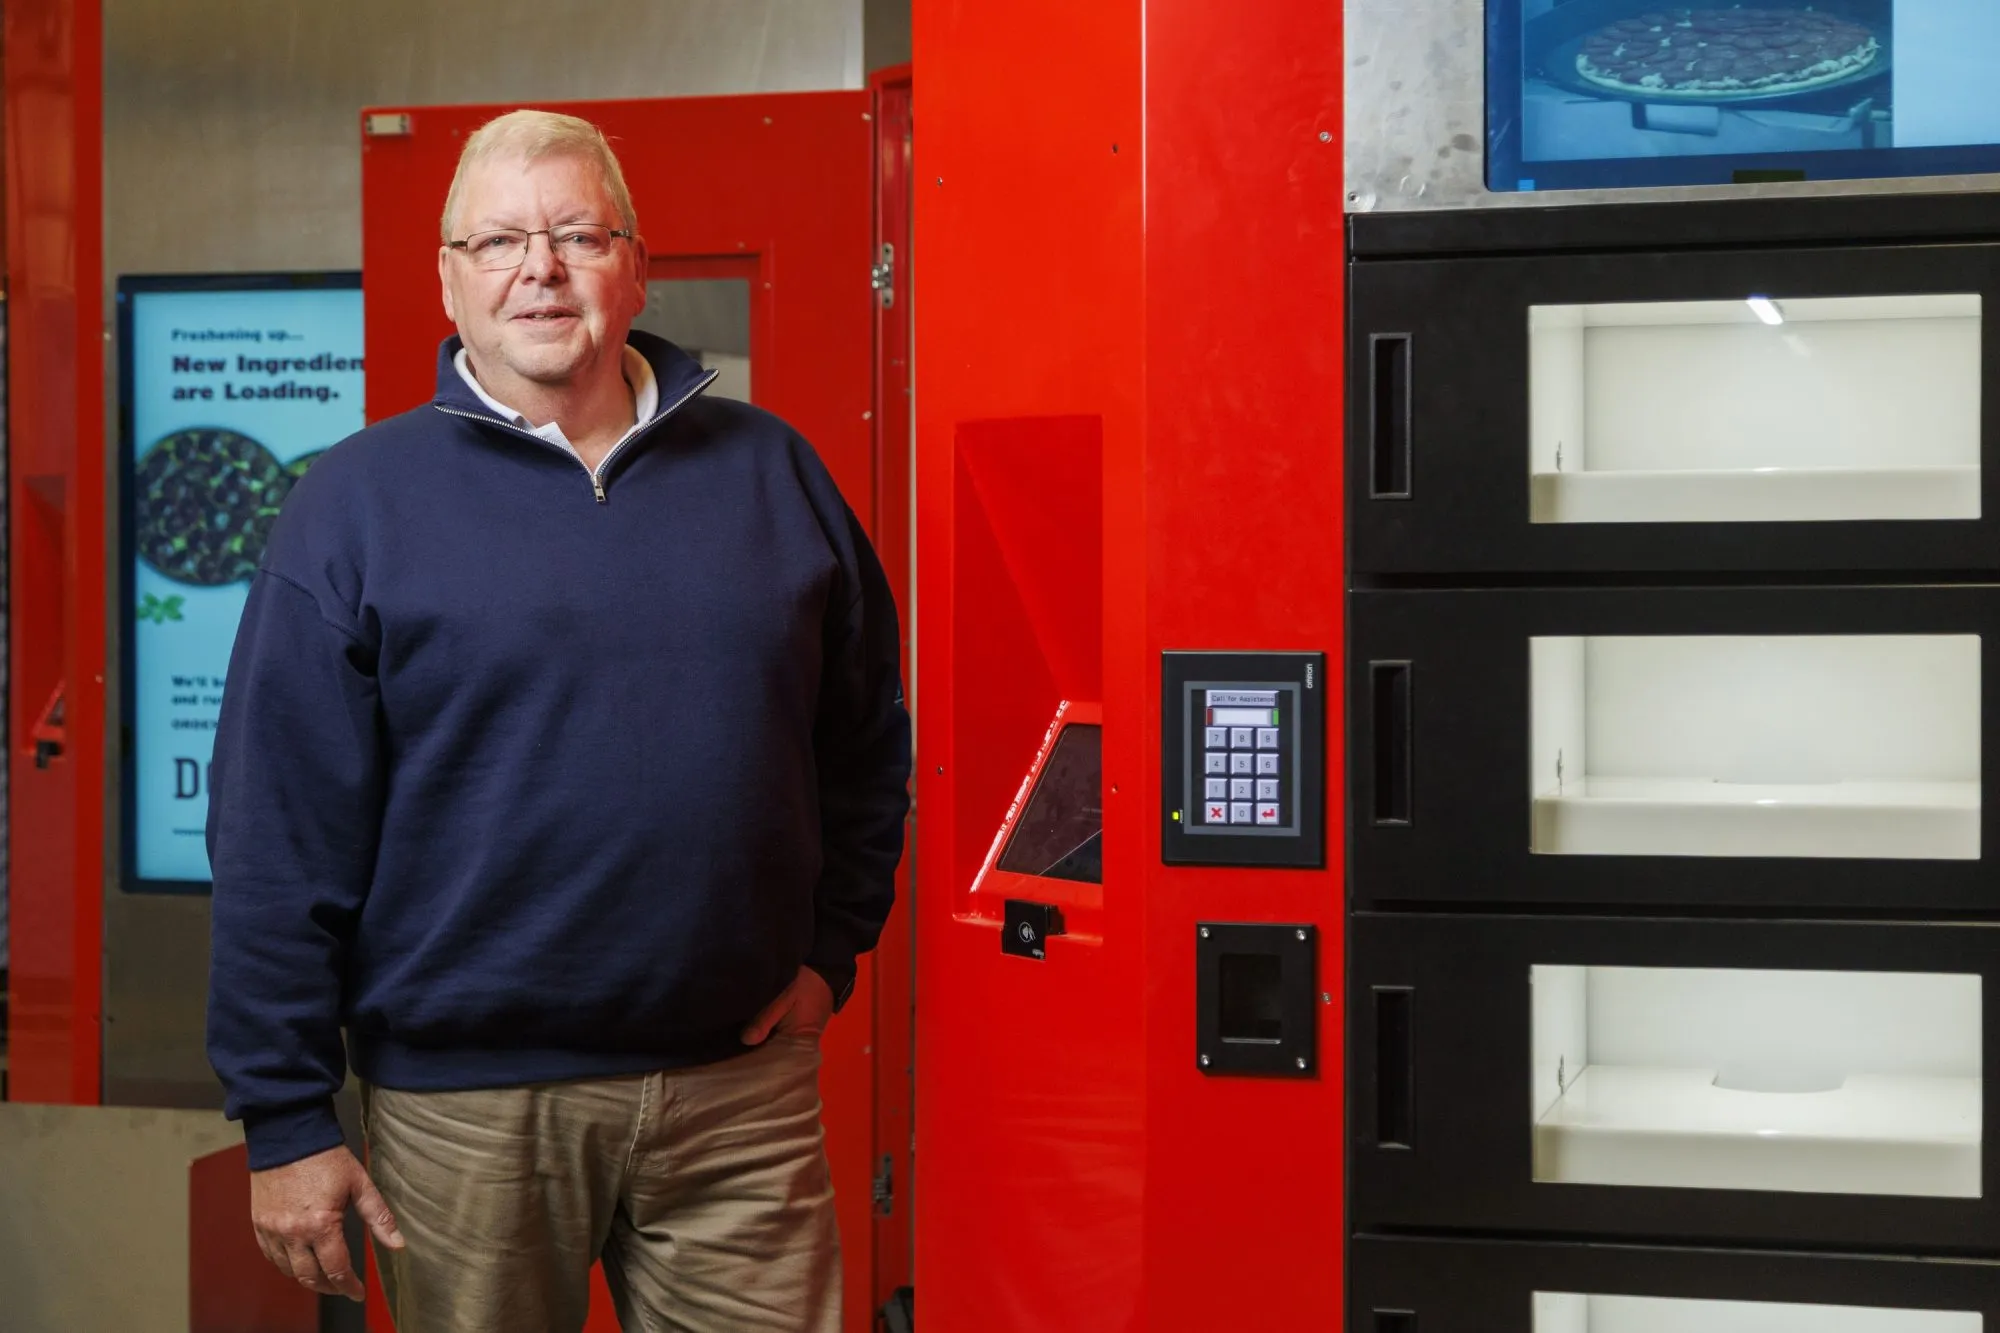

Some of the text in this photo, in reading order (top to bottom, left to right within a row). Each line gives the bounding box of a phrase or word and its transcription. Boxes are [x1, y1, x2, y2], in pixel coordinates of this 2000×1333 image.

[172, 355, 226, 373] New
[172, 380, 340, 402] are Loading.
[1239, 760, 1245, 768] 5
[1265, 761, 1271, 769] 6
[173, 757, 212, 800] D
[1239, 786, 1245, 794] 2
[1265, 786, 1271, 794] 3
